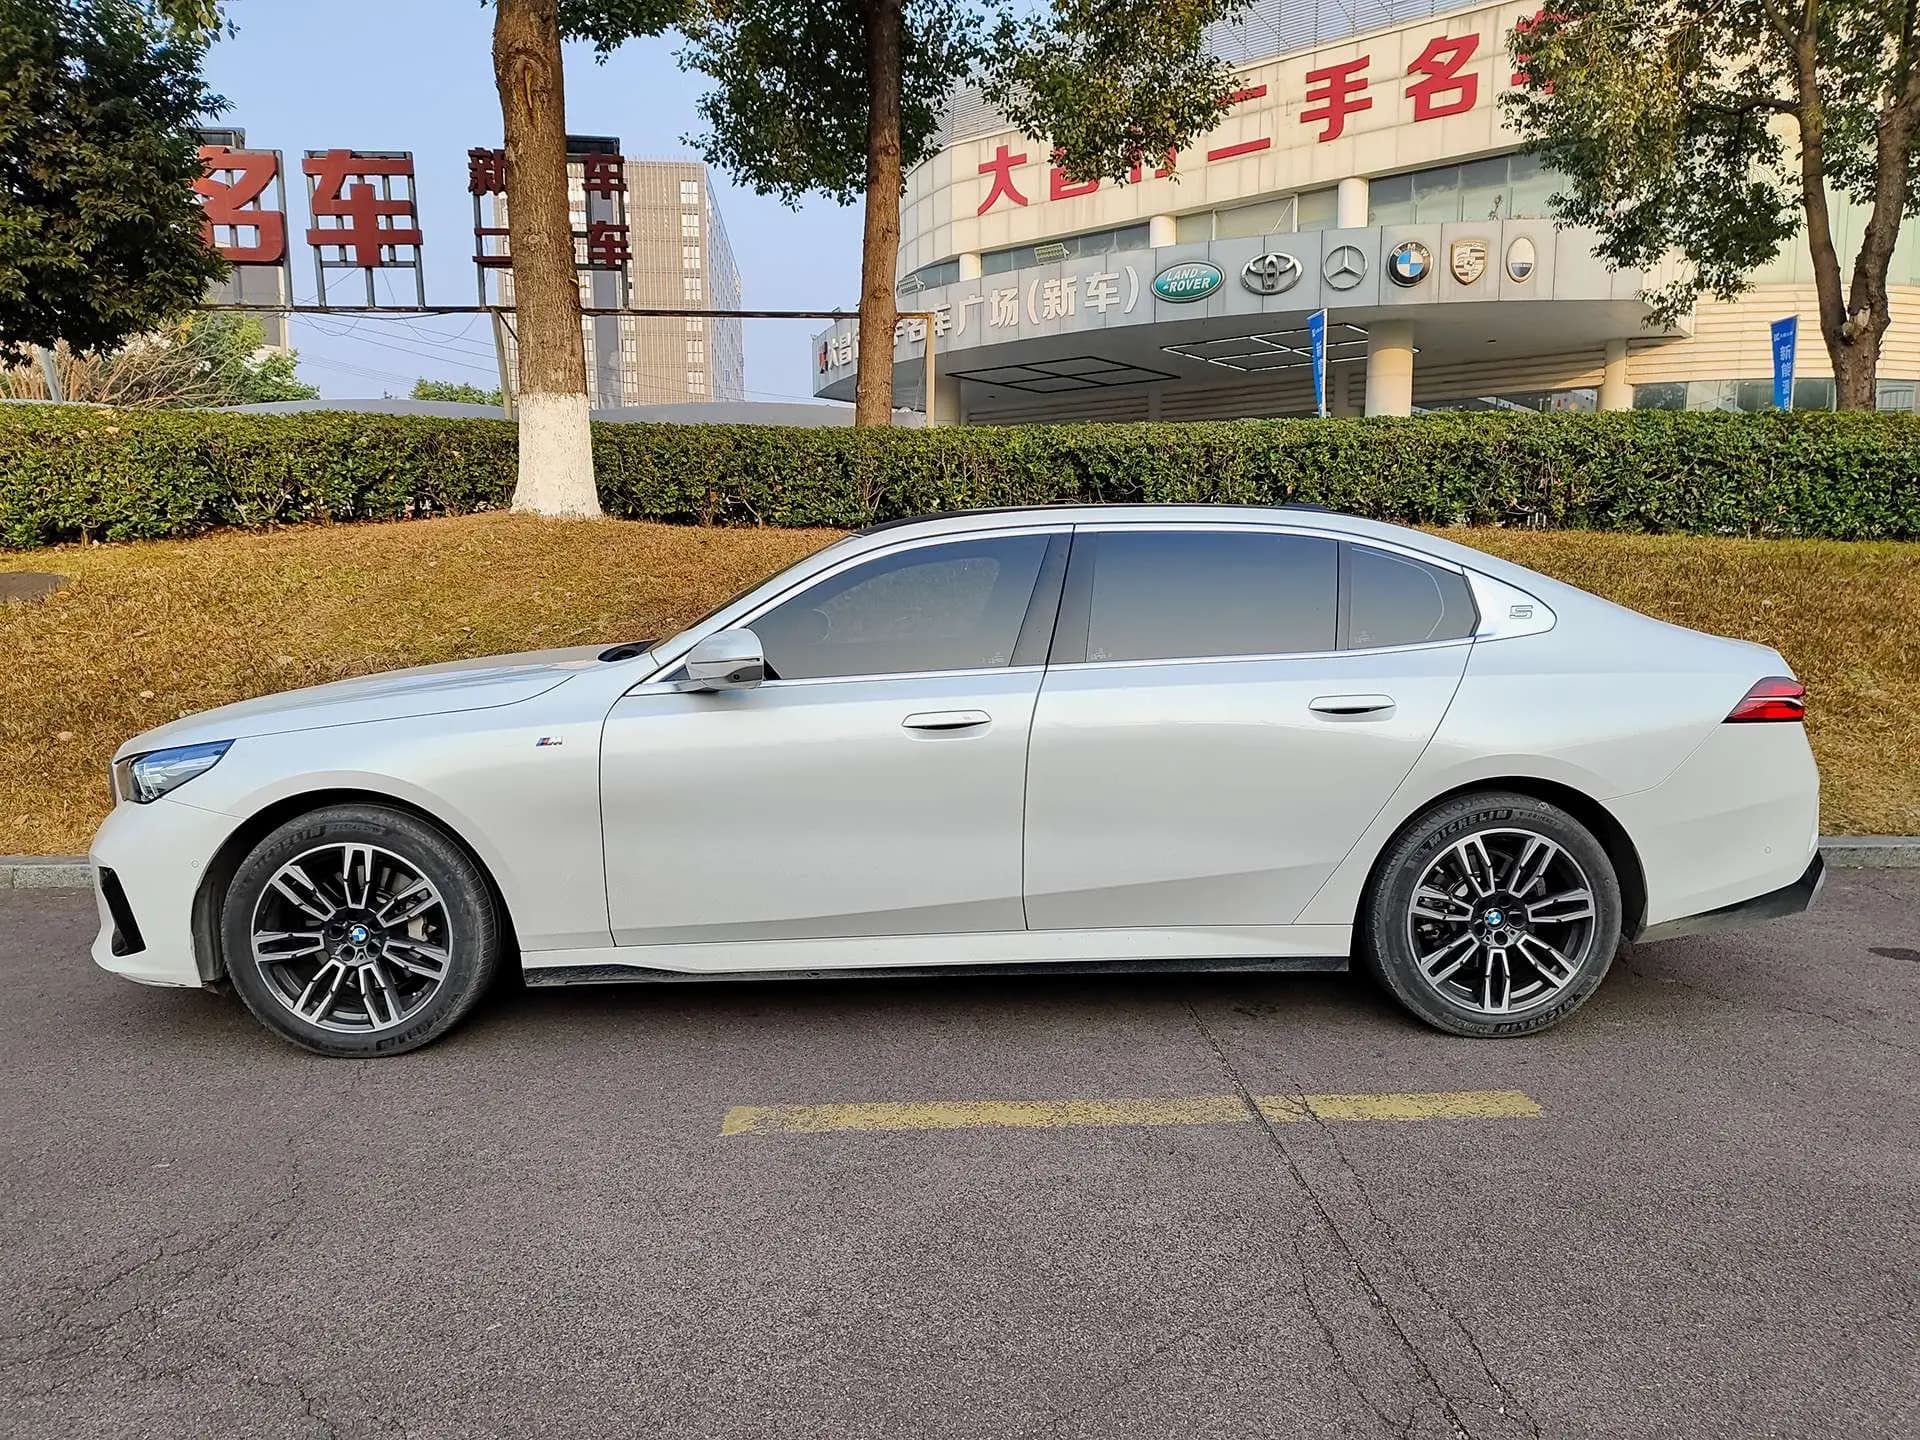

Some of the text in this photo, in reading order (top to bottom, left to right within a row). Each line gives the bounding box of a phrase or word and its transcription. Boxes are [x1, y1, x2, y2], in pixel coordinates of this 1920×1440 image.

[1166, 268, 1199, 282] LAND
[1169, 277, 1211, 293] ROVER
[1427, 809, 1510, 848] MICHELIN
